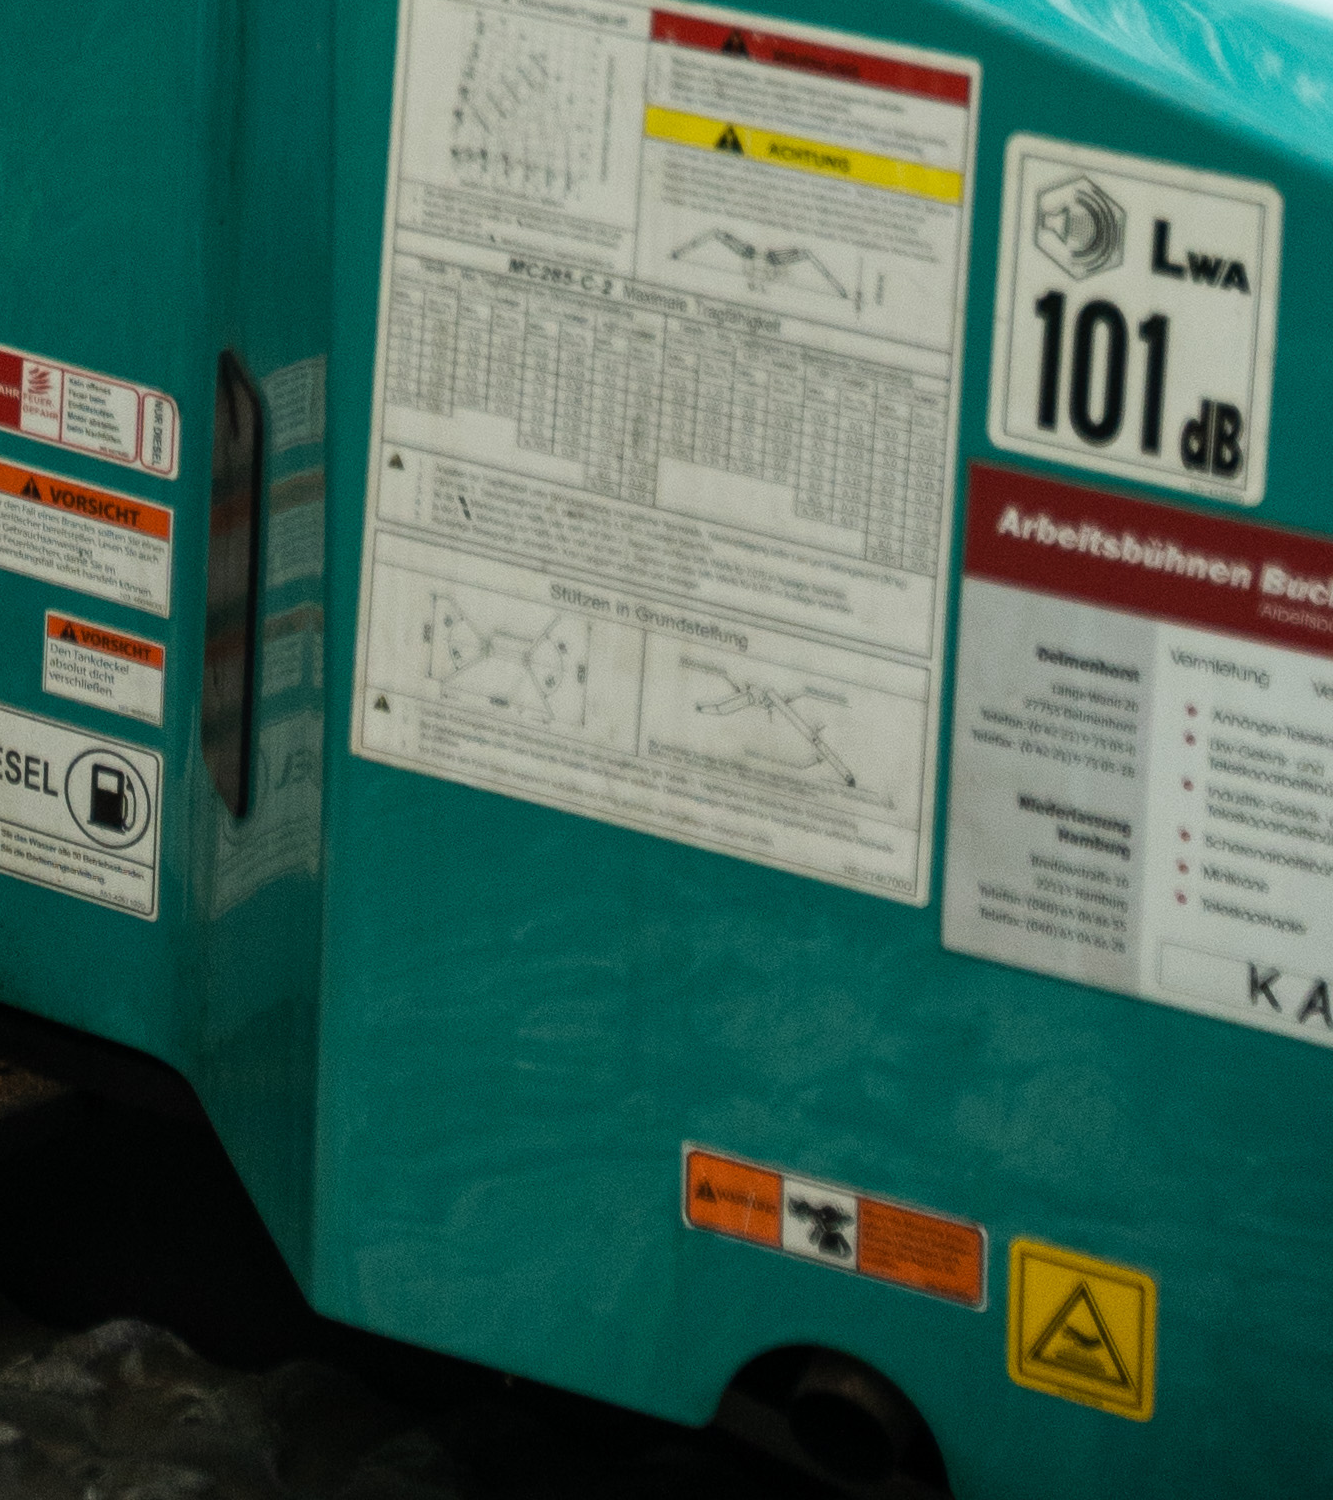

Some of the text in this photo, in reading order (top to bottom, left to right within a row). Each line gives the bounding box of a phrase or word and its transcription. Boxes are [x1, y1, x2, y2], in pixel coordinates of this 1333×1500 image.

[68, 388, 87, 400] Feuer
[69, 377, 111, 395] Kein offenes
[1034, 289, 1171, 458] 101
[1180, 395, 1244, 480] dB
[22, 401, 58, 421] GEFAHR
[67, 412, 87, 424] Motor
[151, 400, 164, 466] NUR DIESEL
[49, 485, 140, 528] VORSICHT
[3, 522, 93, 559] Gebrauchsanweisung
[4, 498, 20, 512] den
[22, 504, 35, 516] Fall
[37, 509, 58, 523] eines
[61, 515, 94, 533] Brandes
[97, 525, 125, 542] sollten
[127, 533, 139, 546] Sie
[141, 537, 165, 554] einen
[3, 534, 62, 560] Feuerlöschers,
[63, 551, 88, 567] damit
[90, 559, 103, 571] Sie
[104, 563, 116, 575] im
[98, 538, 122, 554] Lesen
[124, 545, 136, 558] Sie
[138, 549, 159, 565] auch
[997, 500, 1252, 594] Arbeitsbühnen
[55, 561, 81, 577] sofort
[81, 568, 117, 588] handeln
[550, 583, 748, 653] Stützen in Grundstellung
[50, 643, 129, 675] Den Tankdeckel
[81, 629, 150, 661] VORSICHT
[49, 656, 115, 685] absolut dicht
[1036, 645, 1139, 684] Delmenhorst
[1168, 646, 1270, 691] Vermietung
[1063, 705, 1137, 735] Delmenhorst
[1017, 793, 1131, 838] Niederlassung
[1, 827, 13, 839] Sie
[13, 831, 27, 843] das
[29, 836, 57, 853] Wasser
[58, 846, 70, 858] alle
[1, 843, 12, 855] Sie
[1057, 824, 1131, 860] Hamburg
